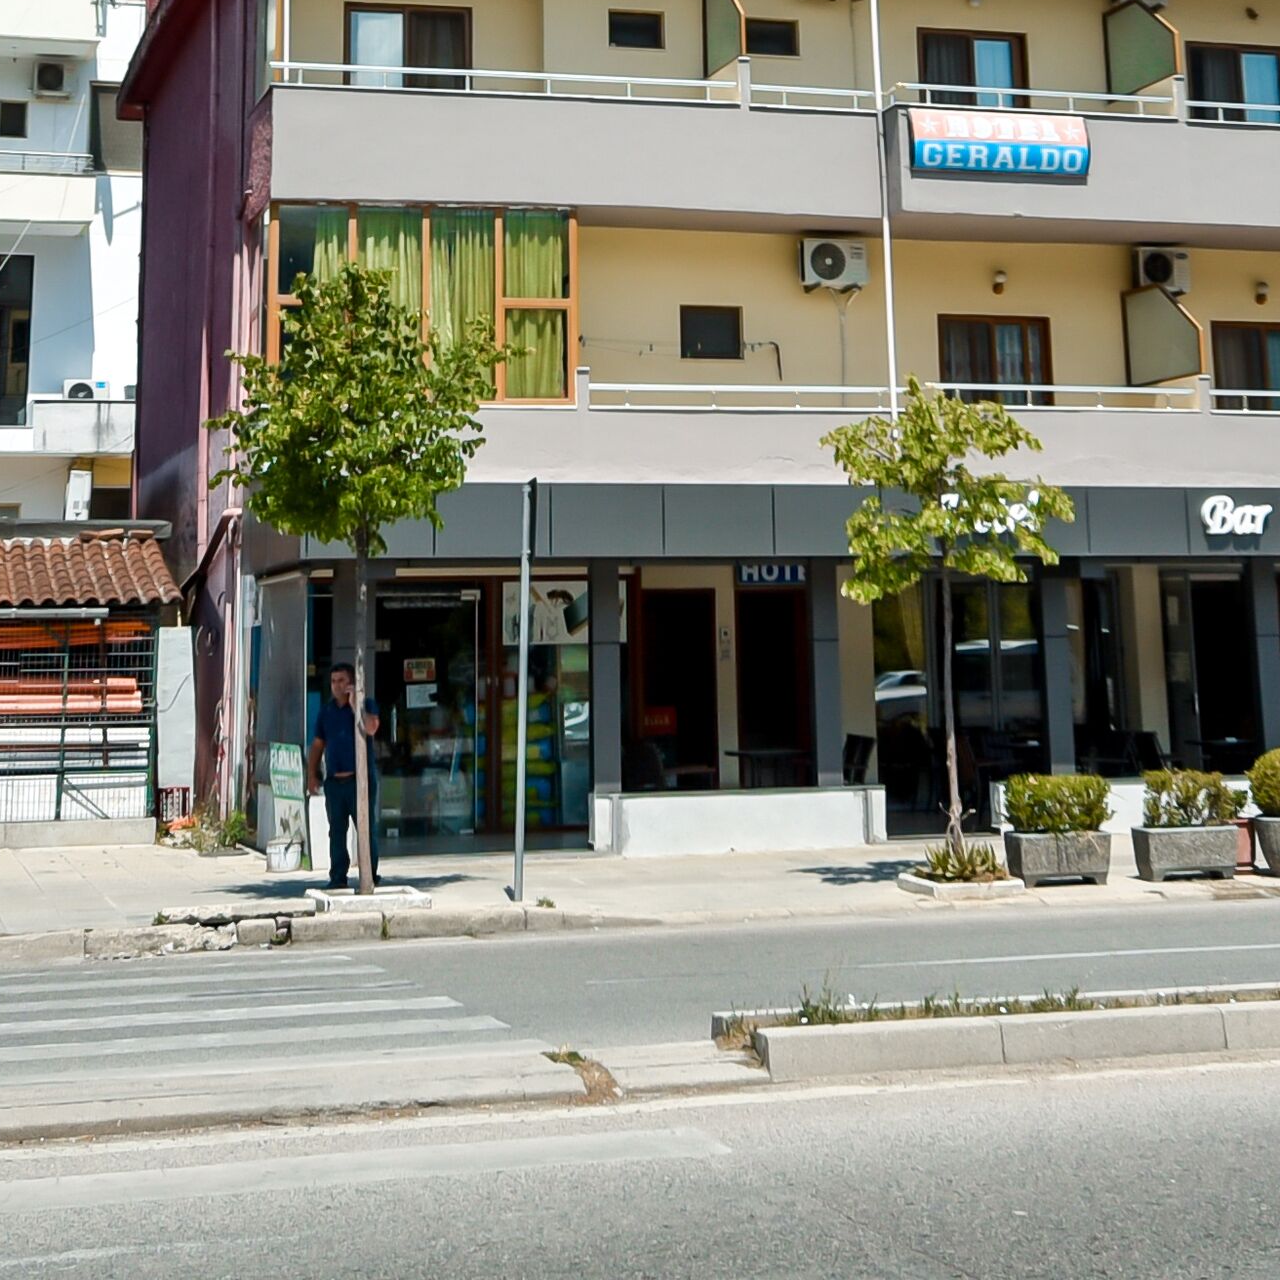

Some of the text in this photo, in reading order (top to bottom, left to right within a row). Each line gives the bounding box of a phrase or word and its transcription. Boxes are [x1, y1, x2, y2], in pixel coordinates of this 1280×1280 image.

[946, 116, 1062, 143] HOTEL
[922, 142, 1083, 172] GERALDO
[1200, 495, 1273, 536] Bar
